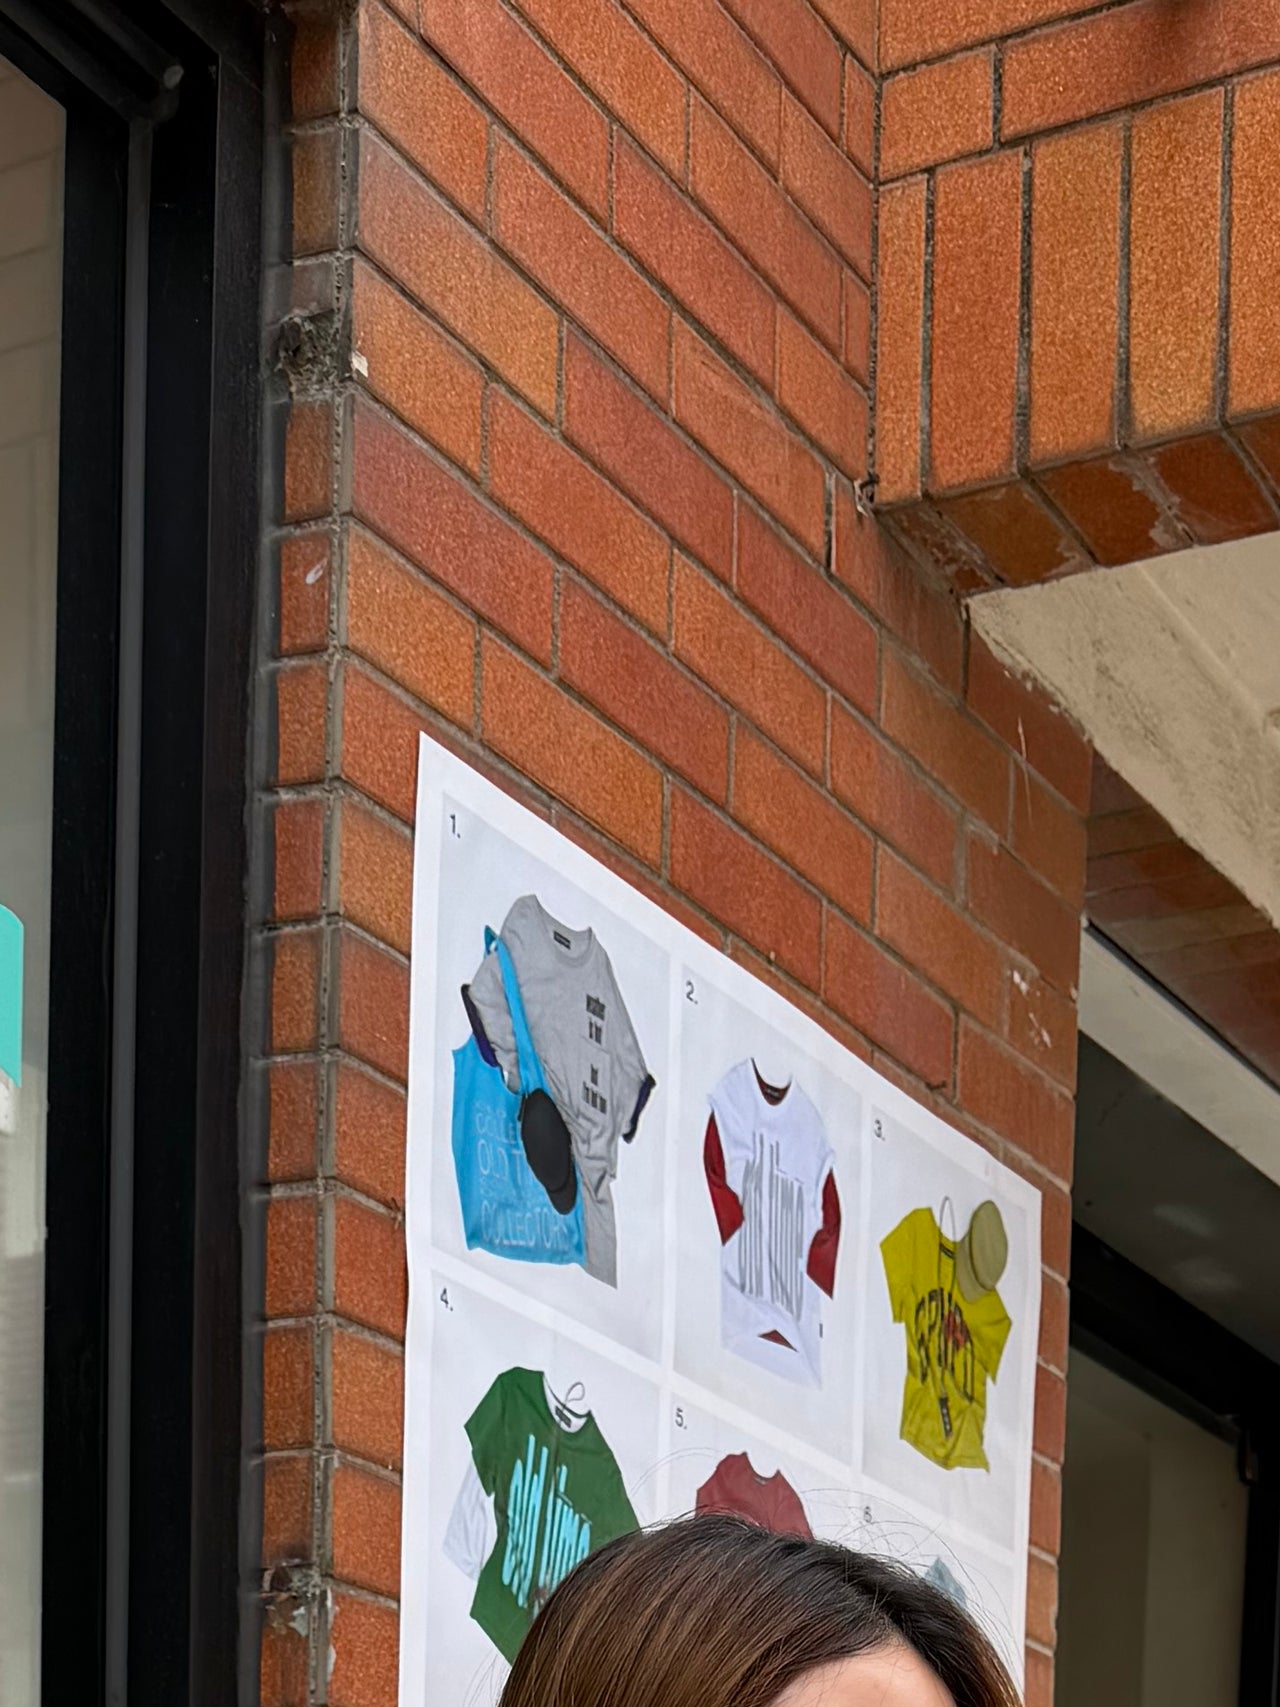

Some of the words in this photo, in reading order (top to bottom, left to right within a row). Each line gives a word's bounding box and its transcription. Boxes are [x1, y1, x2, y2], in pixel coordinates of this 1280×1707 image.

[449, 814, 461, 839] 1.
[686, 980, 699, 1005] 2.
[874, 1119, 886, 1142] 3.
[439, 1287, 454, 1312] 4.
[675, 1407, 688, 1430] 5.
